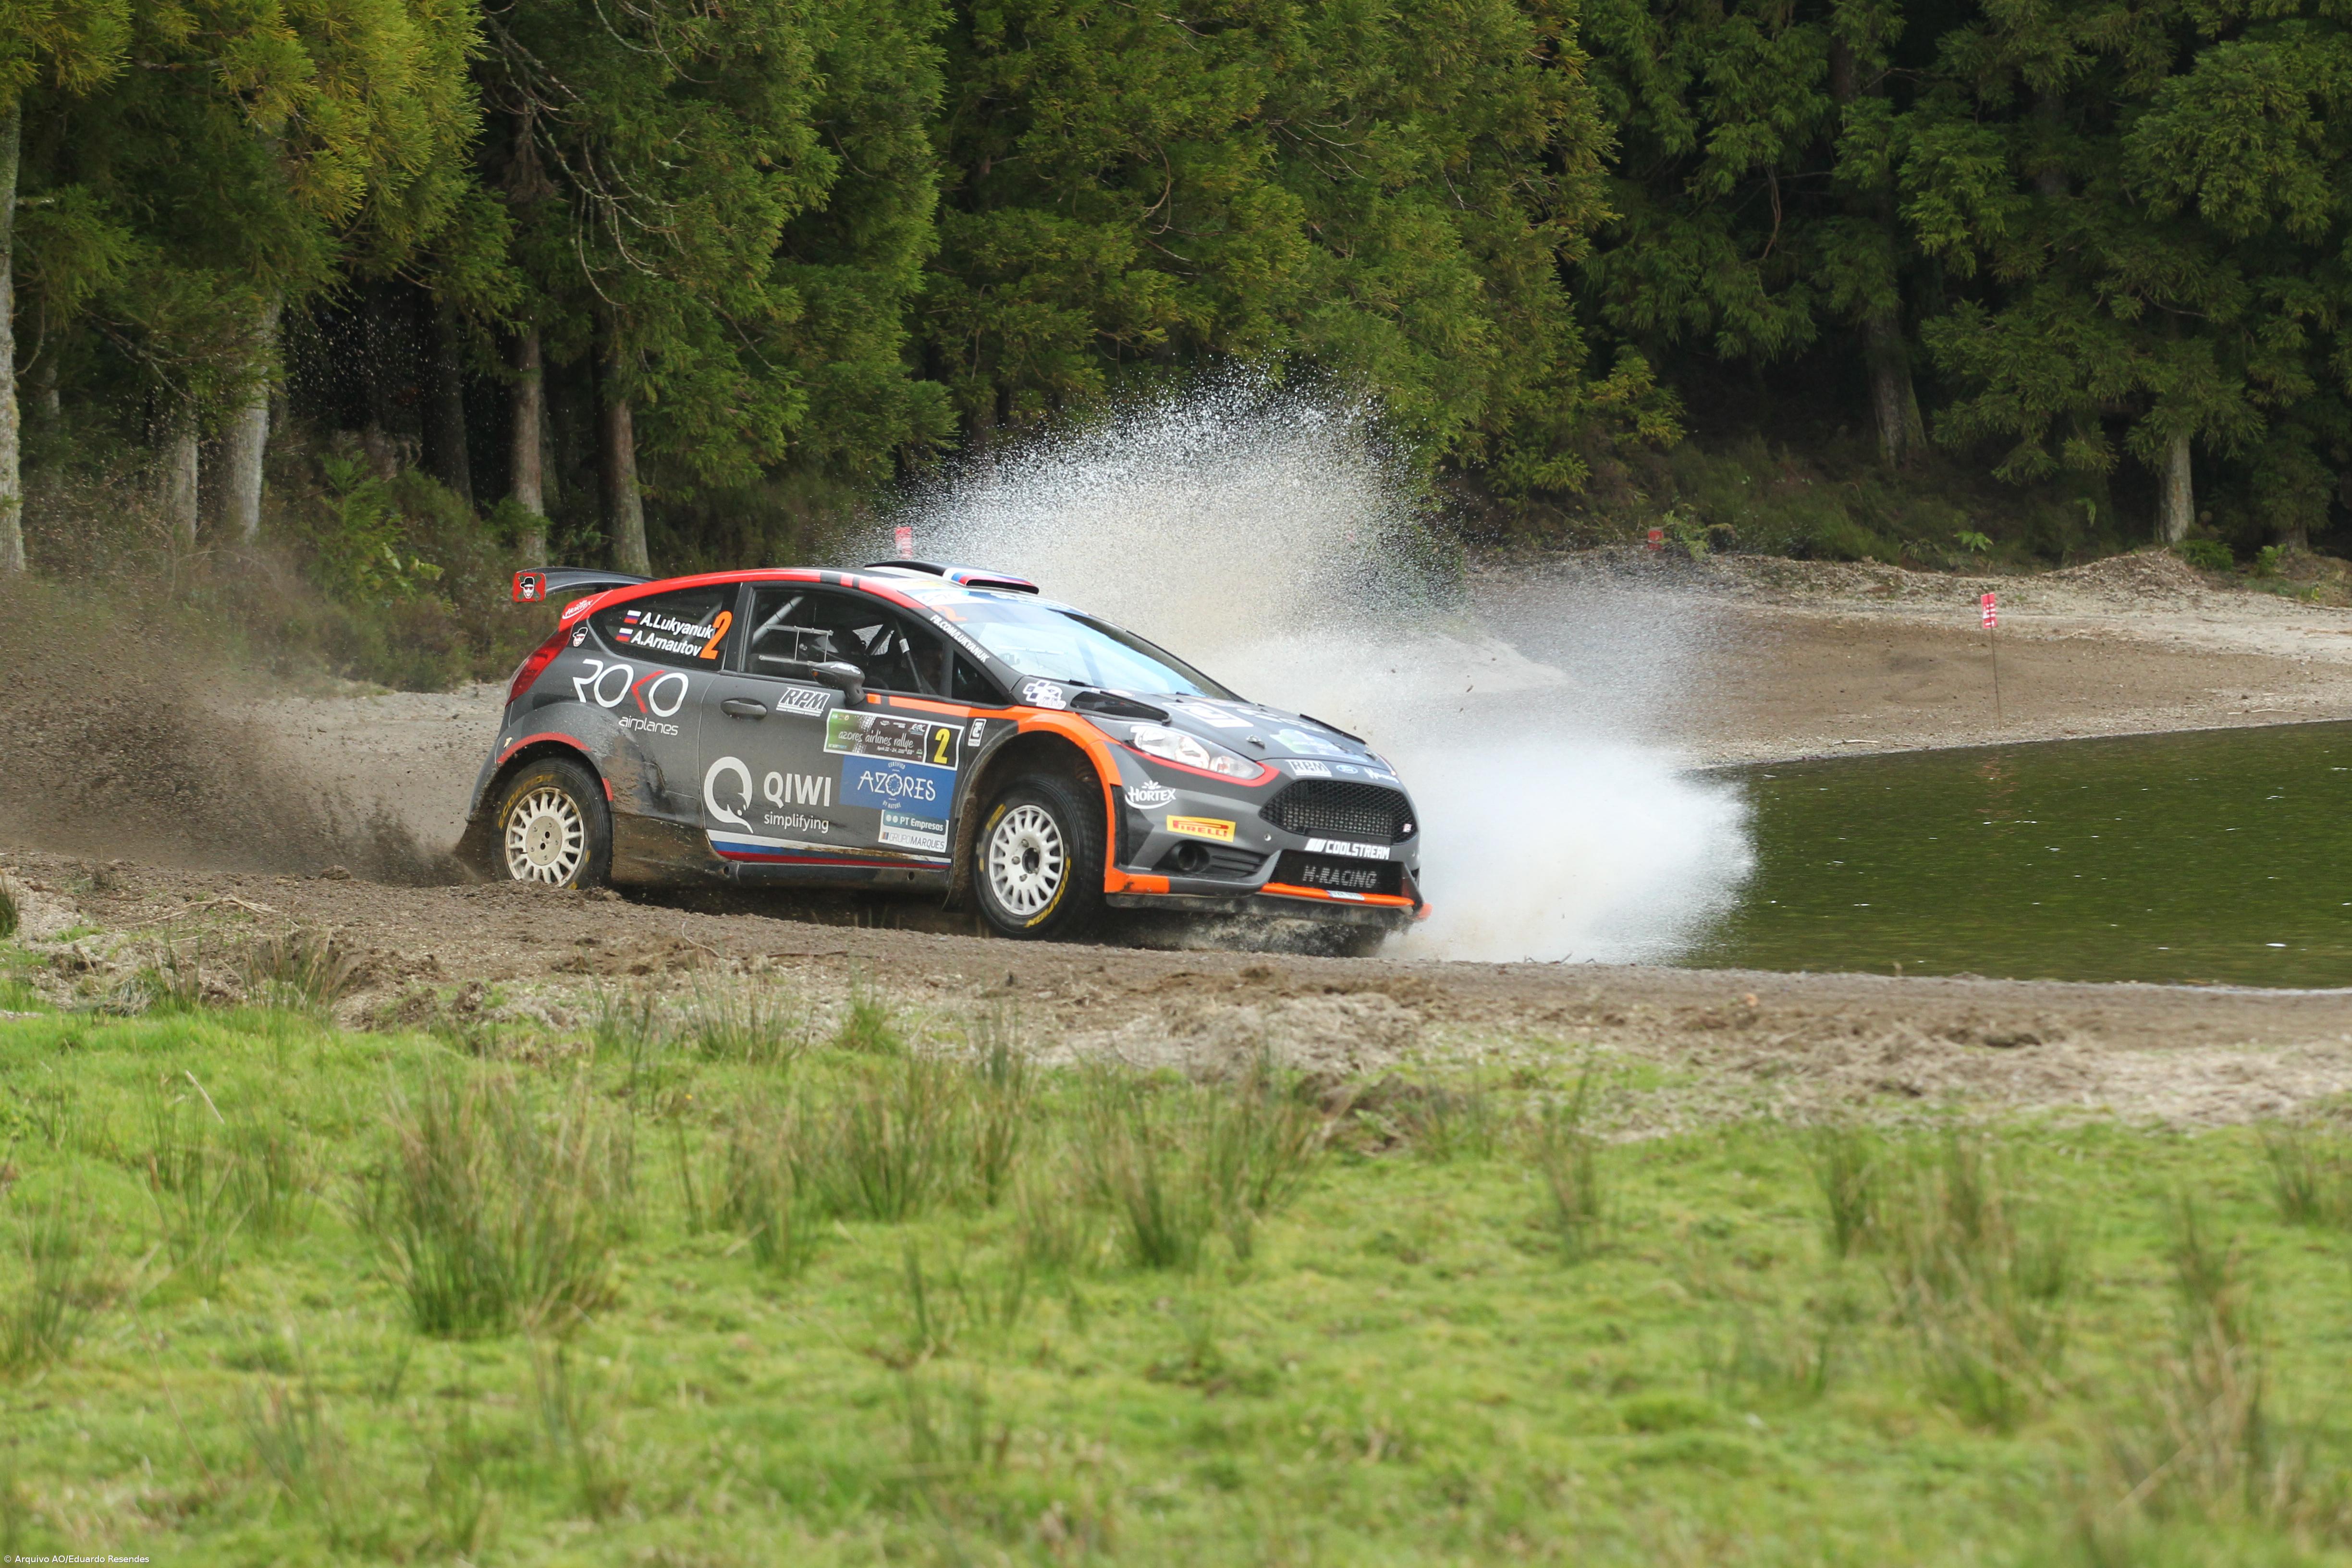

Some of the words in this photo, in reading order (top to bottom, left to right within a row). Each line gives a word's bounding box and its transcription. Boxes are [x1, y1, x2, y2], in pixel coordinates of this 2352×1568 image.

[640, 612, 715, 639] A.Lukyanuk
[699, 611, 733, 660] 2
[631, 630, 702, 657] A.Arnautov
[930, 614, 990, 662] FB.COM/LUKYANUK
[778, 687, 831, 711] RPM
[618, 716, 679, 736] airplanes
[838, 731, 863, 743] azores
[865, 729, 892, 746] airlines
[894, 733, 914, 752] rallye
[933, 728, 951, 765] 2
[764, 772, 832, 808] QIWI
[858, 771, 936, 801] AZORES
[1128, 786, 1176, 802] HORTEX
[764, 811, 829, 834] simplifying
[900, 817, 908, 825] PT
[911, 819, 943, 832] Empresas
[1173, 820, 1229, 837] PIRELLI
[889, 832, 945, 850] GRUPOMARQUES
[1325, 841, 1390, 860] COOLSTREAM
[1302, 865, 1377, 888] H-RACING
